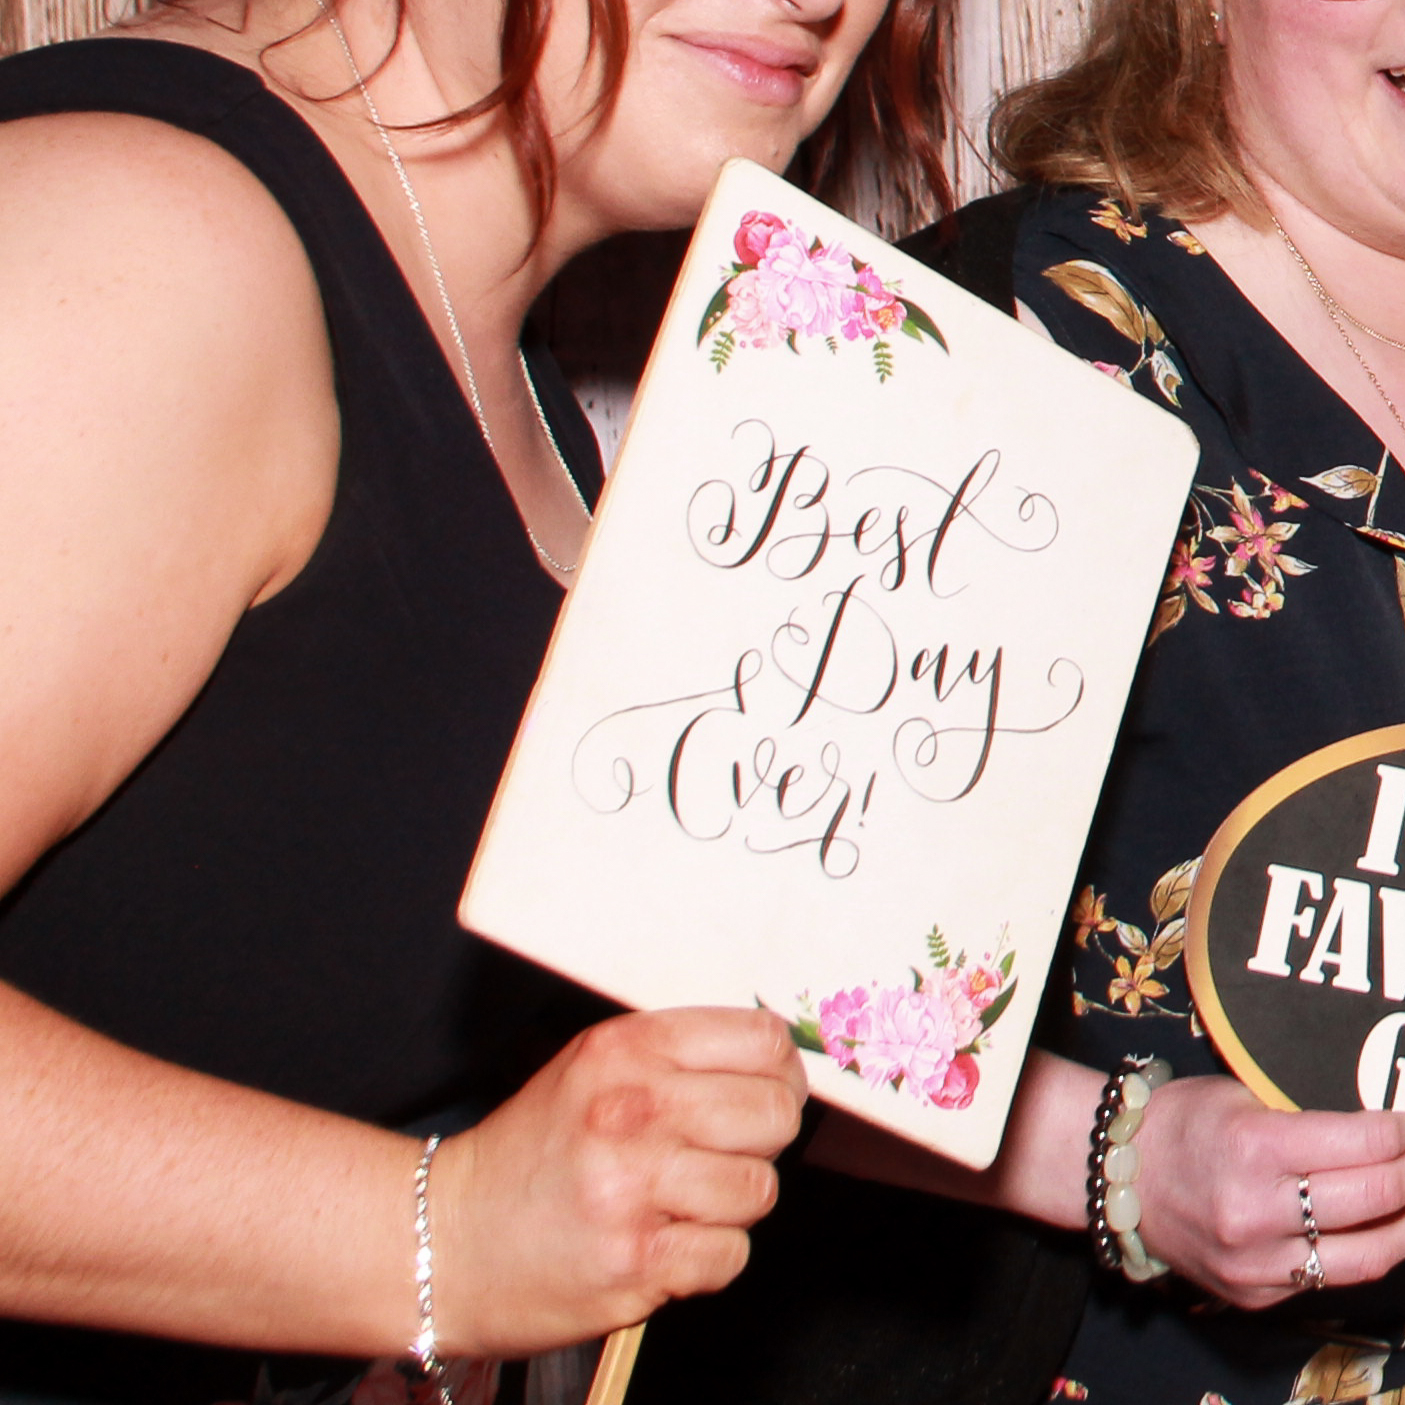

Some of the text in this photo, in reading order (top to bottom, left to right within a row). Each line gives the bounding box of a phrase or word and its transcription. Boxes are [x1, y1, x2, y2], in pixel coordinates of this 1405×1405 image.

[687, 419, 1059, 598] Best
[571, 649, 877, 879] Ever!
[771, 575, 1084, 803] Day
